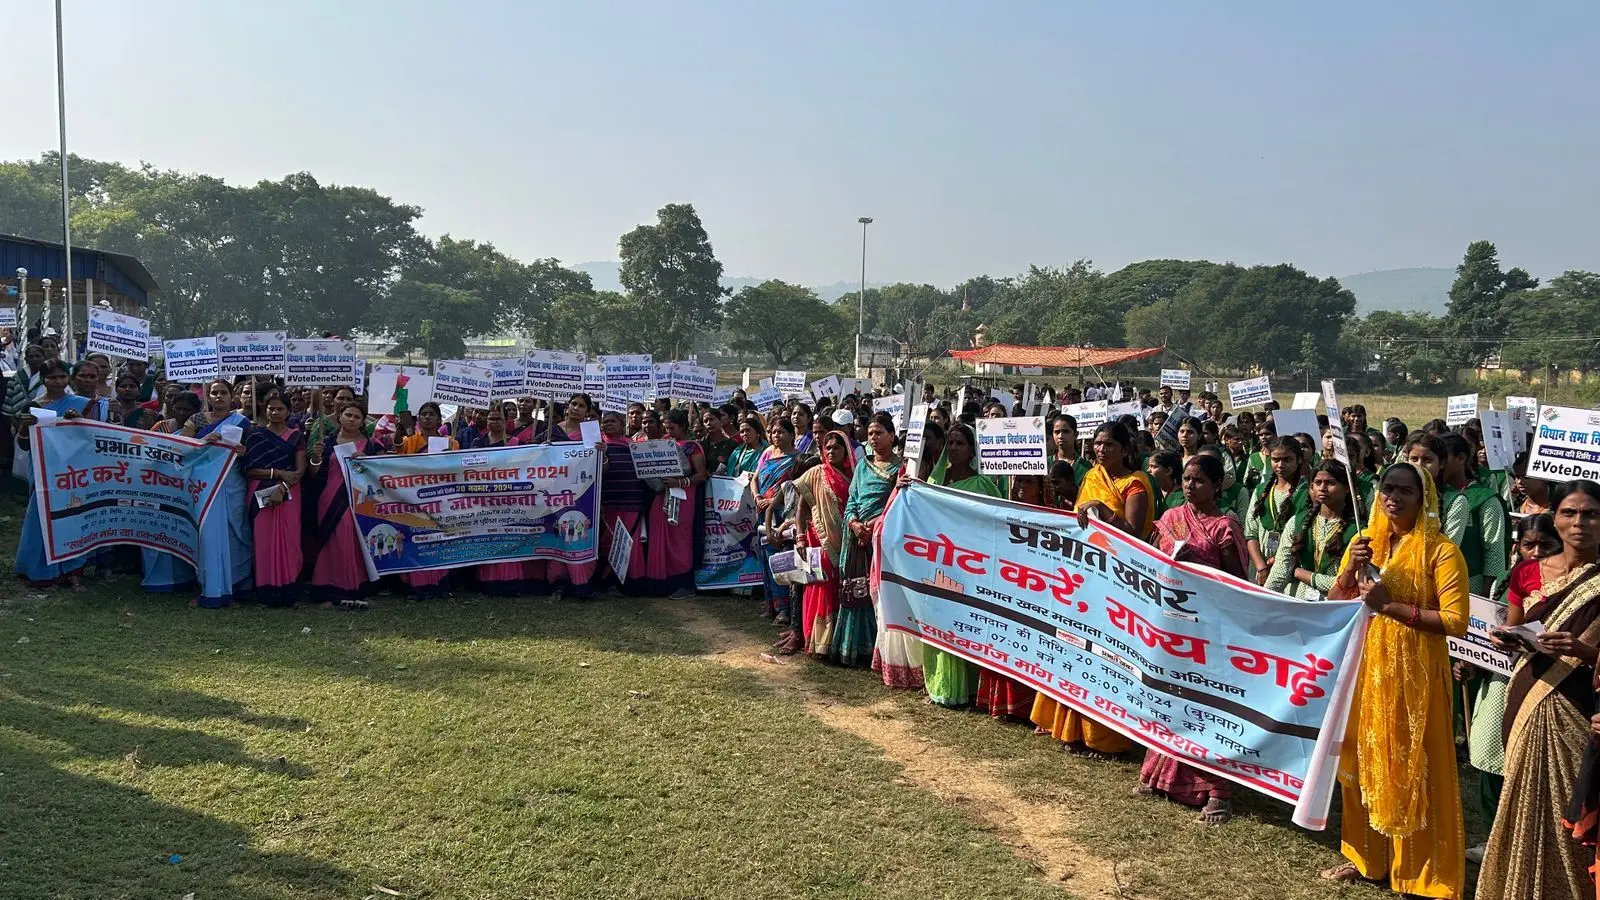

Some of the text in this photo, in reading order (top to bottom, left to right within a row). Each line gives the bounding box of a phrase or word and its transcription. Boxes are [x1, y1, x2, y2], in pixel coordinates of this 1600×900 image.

[89, 340, 147, 358] #VoteDeneChalo
[270, 344, 284, 352] 202
[168, 367, 218, 377] #VoteDeneC
[287, 373, 354, 383] #VoteDeneChalo
[514, 369, 524, 377] 202
[491, 388, 529, 396] DeneChalo
[525, 379, 583, 391] #VoteDeneChalo
[607, 381, 652, 389] oteDeneChalo
[433, 391, 489, 407] #VoteDeneChalo
[671, 389, 714, 400] #VoteDeneChalo
[1233, 395, 1271, 408] #VoteDeneChalo
[979, 432, 1045, 445] विधान सभा निर्वाचन 2024
[1539, 424, 1567, 441] विधान
[1569, 430, 1589, 444] सभा
[94, 438, 185, 467] प्रभात खबर
[1541, 447, 1592, 461] मतदान की तिथि
[638, 467, 682, 476] #VoteDeneChalo
[980, 460, 1045, 471] #VoteDeneChalo
[55, 465, 89, 491] वोट
[91, 460, 132, 485] करें,
[140, 468, 185, 491] राज्य
[379, 465, 569, 491] विधानसभा निर्वाचन 2024
[456, 485, 466, 493] 20
[493, 484, 513, 492] 2024
[373, 488, 577, 516] मतदाता जागरूकता रैली
[1006, 522, 1107, 573] प्रभात
[1111, 556, 1198, 614] खबर
[903, 533, 990, 575] वोट
[999, 558, 1089, 614] करें,
[1105, 595, 1210, 665] राज्य
[1226, 645, 1335, 707] गढ़ें
[975, 585, 1012, 604] प्रभात
[1016, 599, 1050, 617] खबर
[1051, 612, 1102, 638] मतदाता
[1104, 633, 1165, 675] जागरूकता
[1169, 669, 1247, 698] अभियान
[1449, 640, 1514, 672] DeneChalo
[969, 611, 1009, 632] मतदान
[1016, 626, 1032, 641] की
[1038, 632, 1068, 656] तिथि:
[1075, 653, 1093, 667] 20
[1100, 663, 1135, 688] नवम्बर
[1139, 687, 1173, 709] 2024
[1184, 703, 1245, 737] (बुधवार)
[952, 619, 983, 636] सुबह
[990, 632, 1029, 653] 07:00
[1036, 649, 1055, 666] बजे
[1062, 661, 1073, 673] से
[1081, 671, 1119, 695] 05:00
[1150, 708, 1173, 724] तक
[1181, 717, 1207, 736] करें
[1214, 732, 1262, 759] मतदान
[1014, 656, 1055, 683] मांग
[1057, 677, 1091, 701] रहा
[1093, 695, 1209, 761] शत-प्रतिशत
